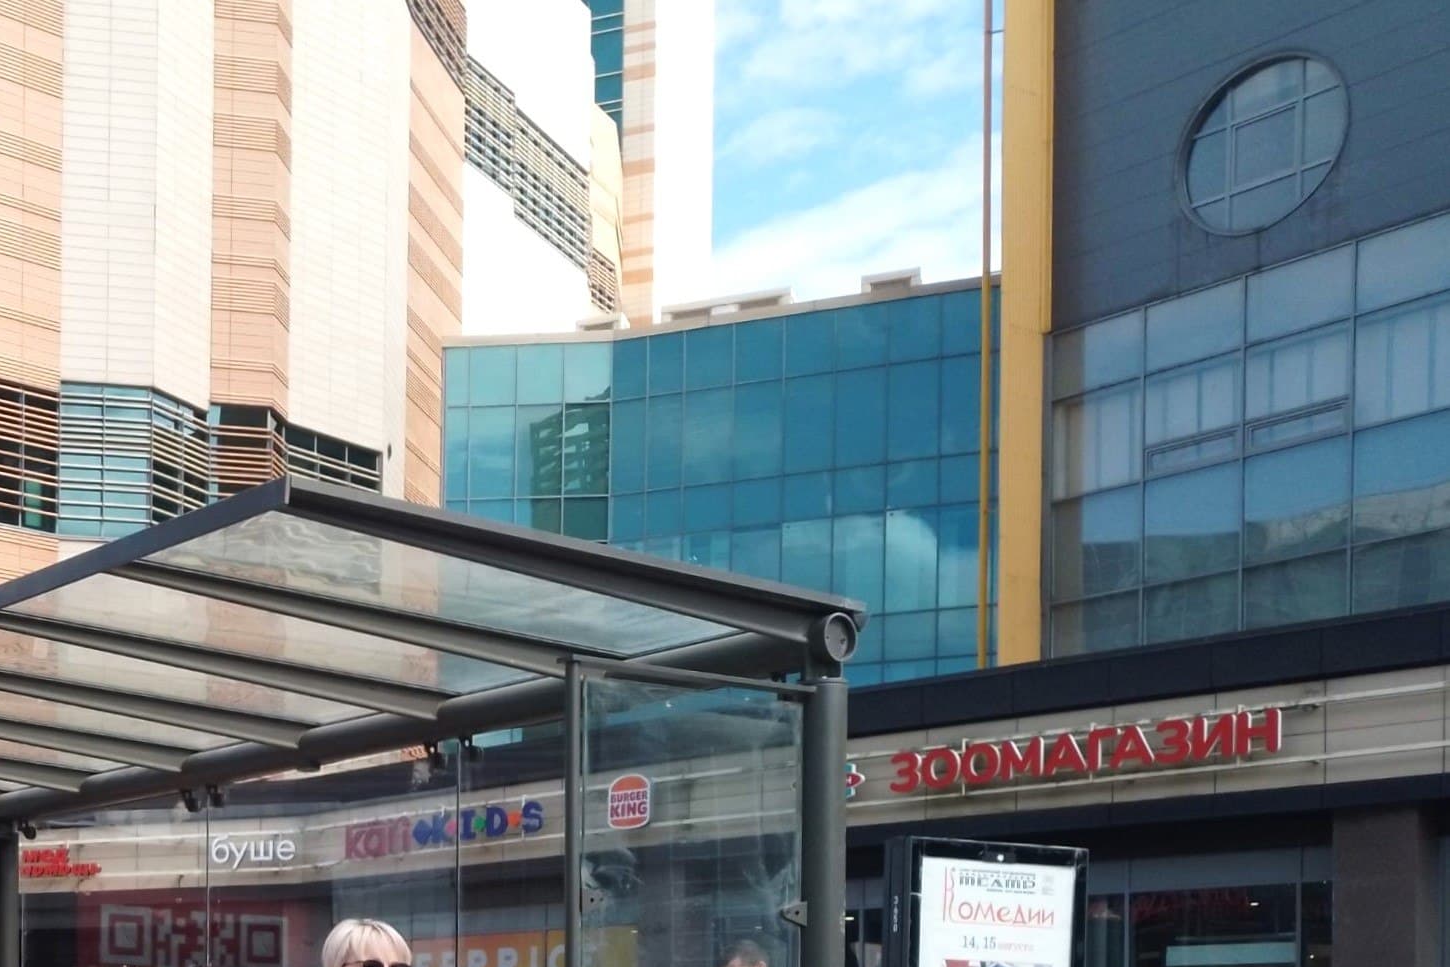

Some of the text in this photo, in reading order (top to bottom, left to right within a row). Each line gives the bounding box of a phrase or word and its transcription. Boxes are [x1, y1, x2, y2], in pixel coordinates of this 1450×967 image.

[889, 708, 1283, 793] ЗООМАГАЗИН
[610, 790, 649, 803] BURGER
[610, 801, 649, 818] KING
[211, 834, 297, 869] буше
